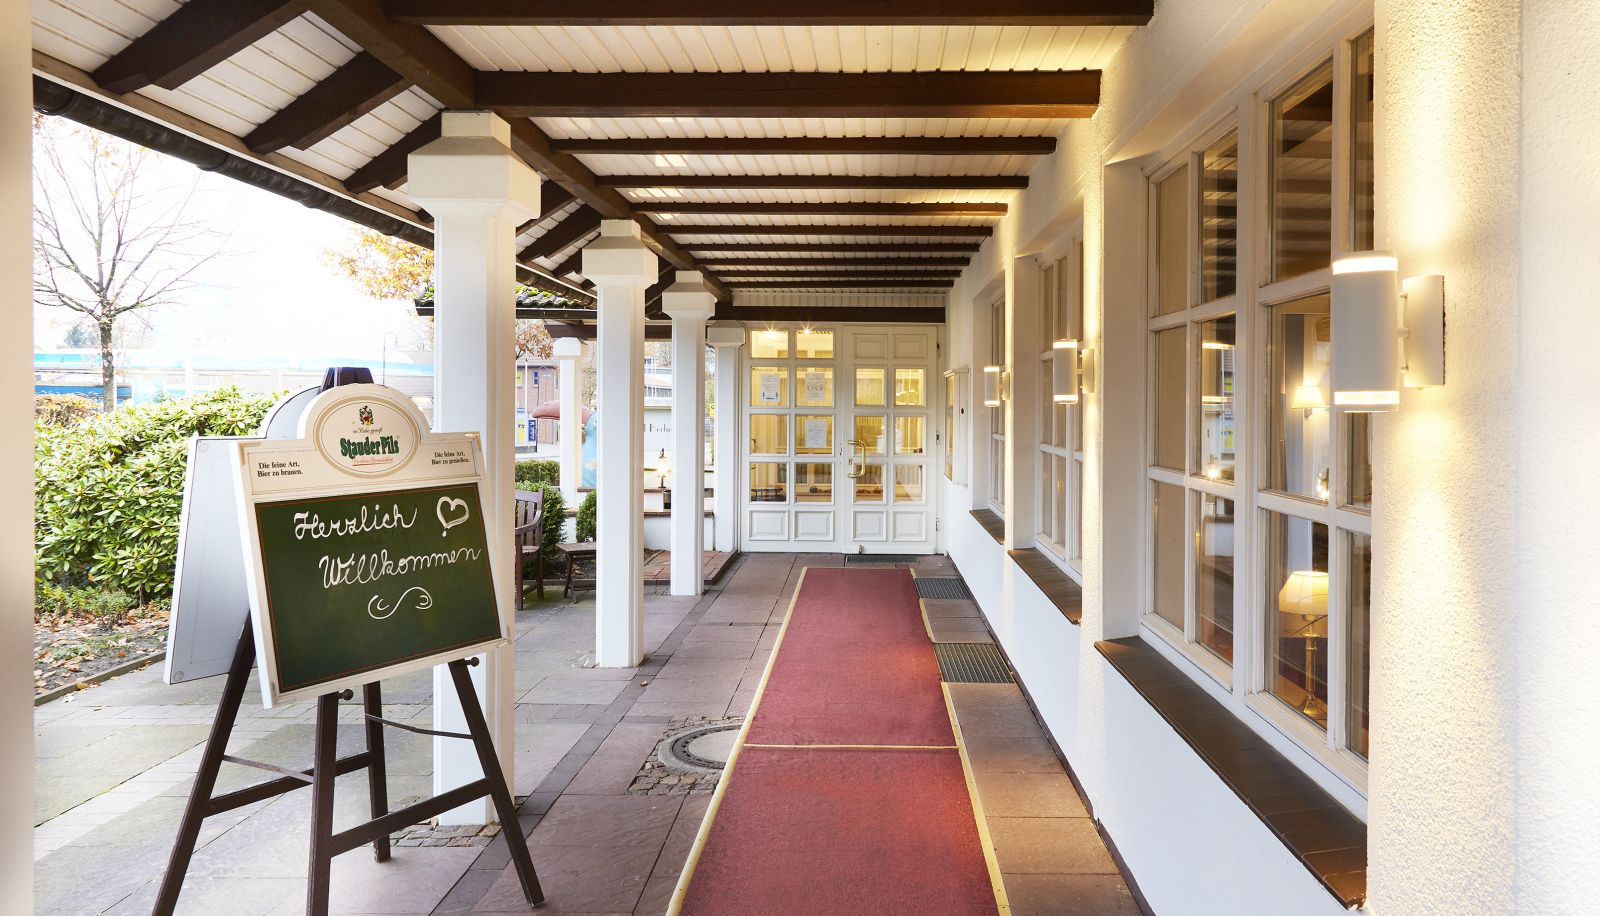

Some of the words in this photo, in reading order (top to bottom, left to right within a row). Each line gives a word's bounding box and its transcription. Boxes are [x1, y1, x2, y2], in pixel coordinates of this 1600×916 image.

[257, 470, 270, 478] Bier
[271, 461, 287, 469] feine
[293, 503, 418, 540] Herzlich
[318, 546, 482, 589] Willkommen
